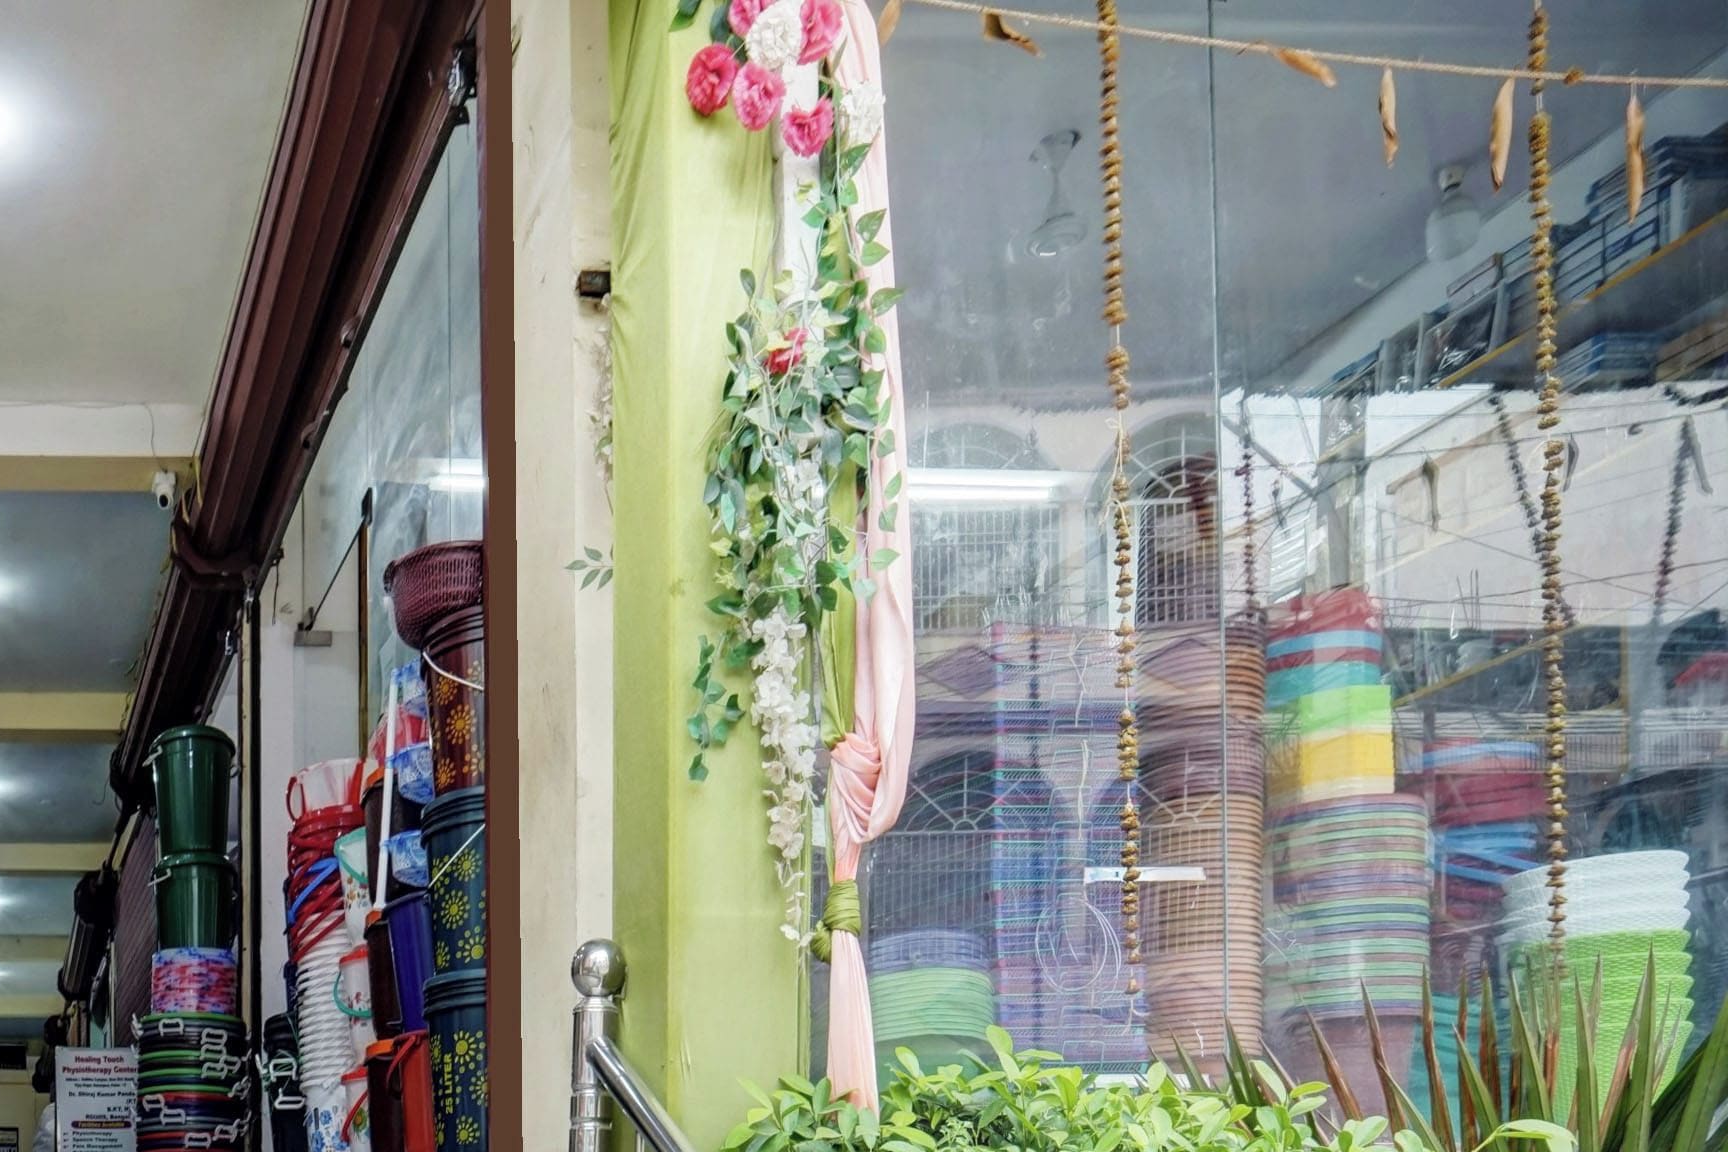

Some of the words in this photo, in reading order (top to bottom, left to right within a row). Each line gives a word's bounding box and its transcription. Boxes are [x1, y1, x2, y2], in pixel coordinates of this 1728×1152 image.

[75, 1056, 101, 1064] Healing
[62, 1066, 112, 1075] Physiotherapy
[443, 1053, 452, 1094] LITER
[445, 1097, 453, 1114] 25
